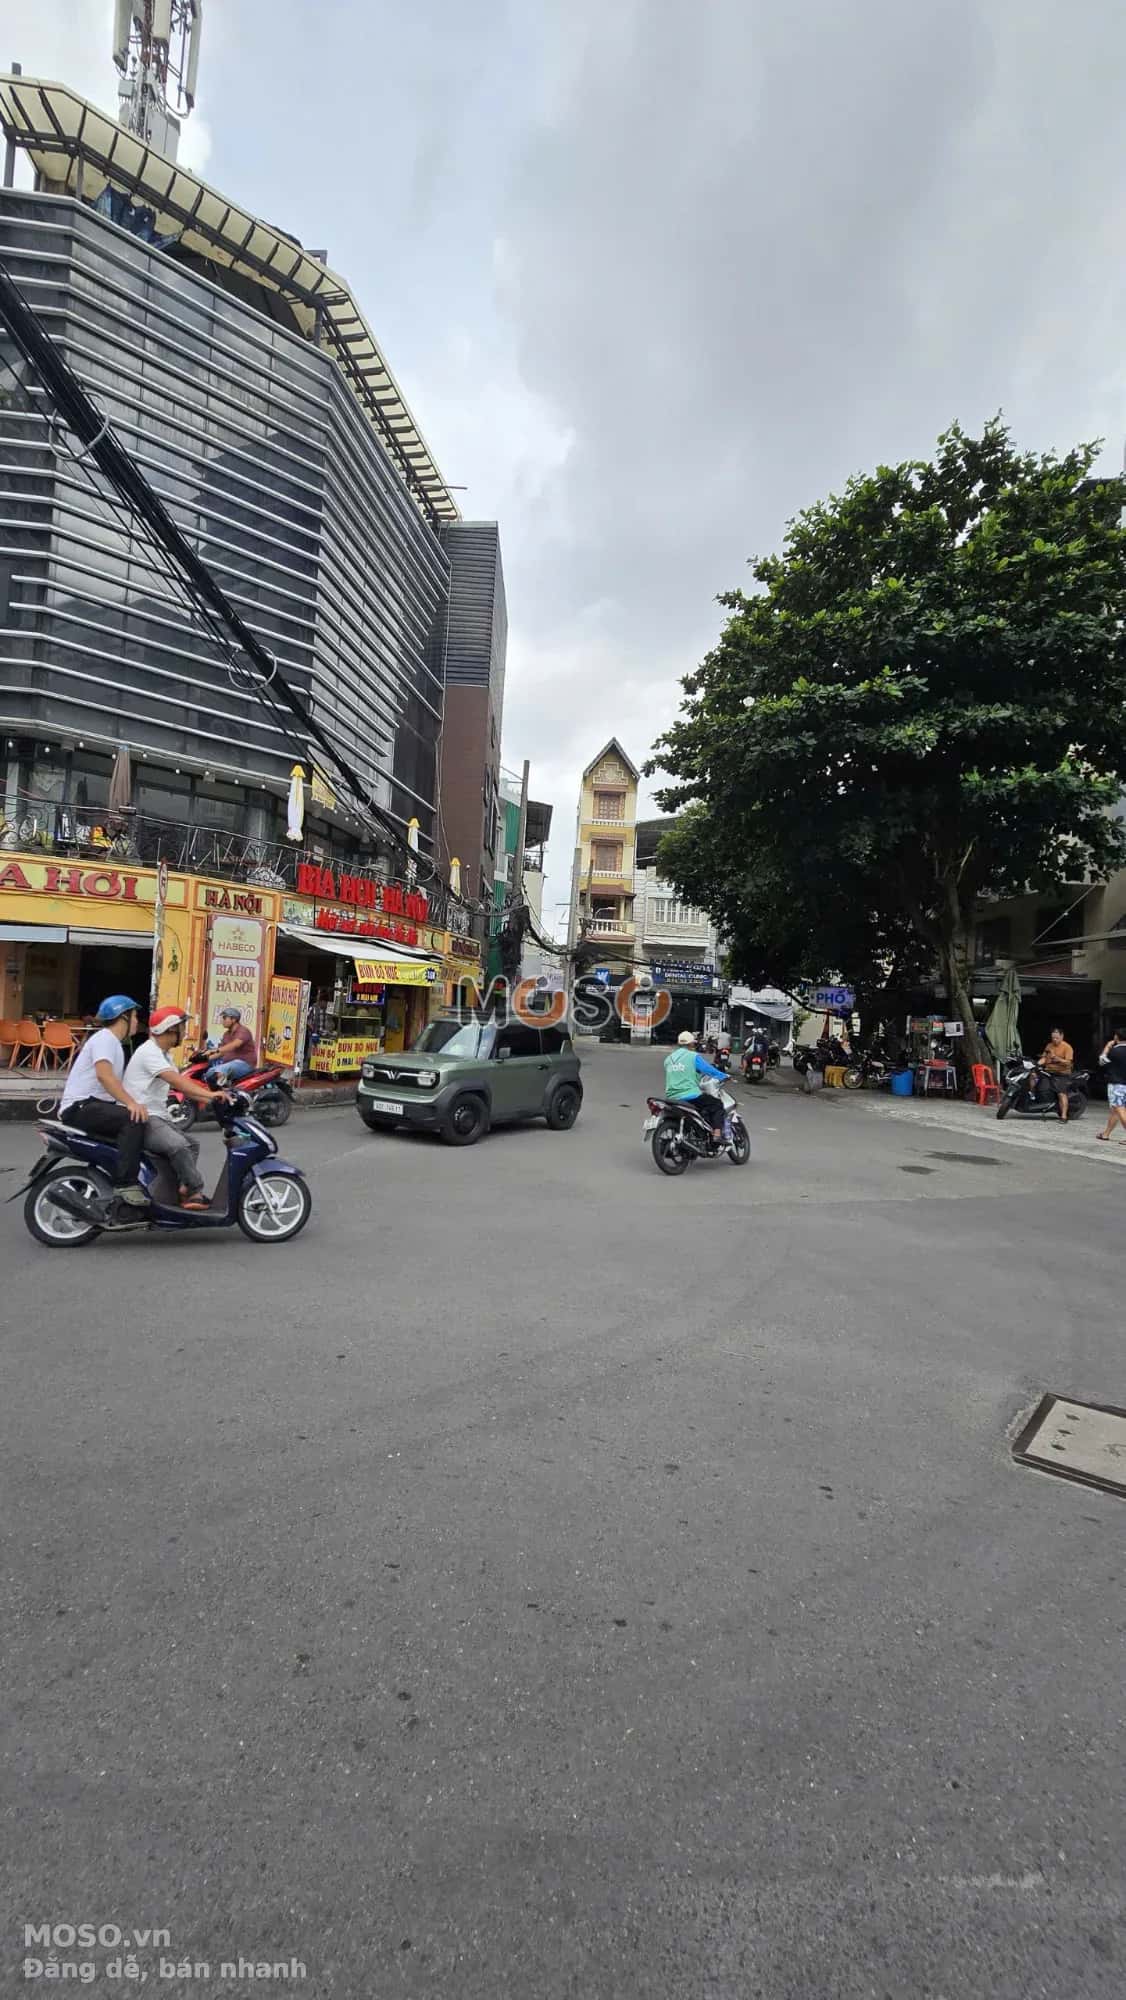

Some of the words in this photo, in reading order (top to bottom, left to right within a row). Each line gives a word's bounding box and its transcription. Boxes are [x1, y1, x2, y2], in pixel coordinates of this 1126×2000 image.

[44, 867, 137, 900] HƠI
[205, 888, 231, 909] HÀ
[233, 892, 262, 915] NỘI
[218, 942, 256, 952] HABECO
[216, 963, 233, 976] BIA
[236, 965, 256, 978] HƠI
[216, 978, 232, 992] HÀ
[234, 980, 254, 995] NỘI
